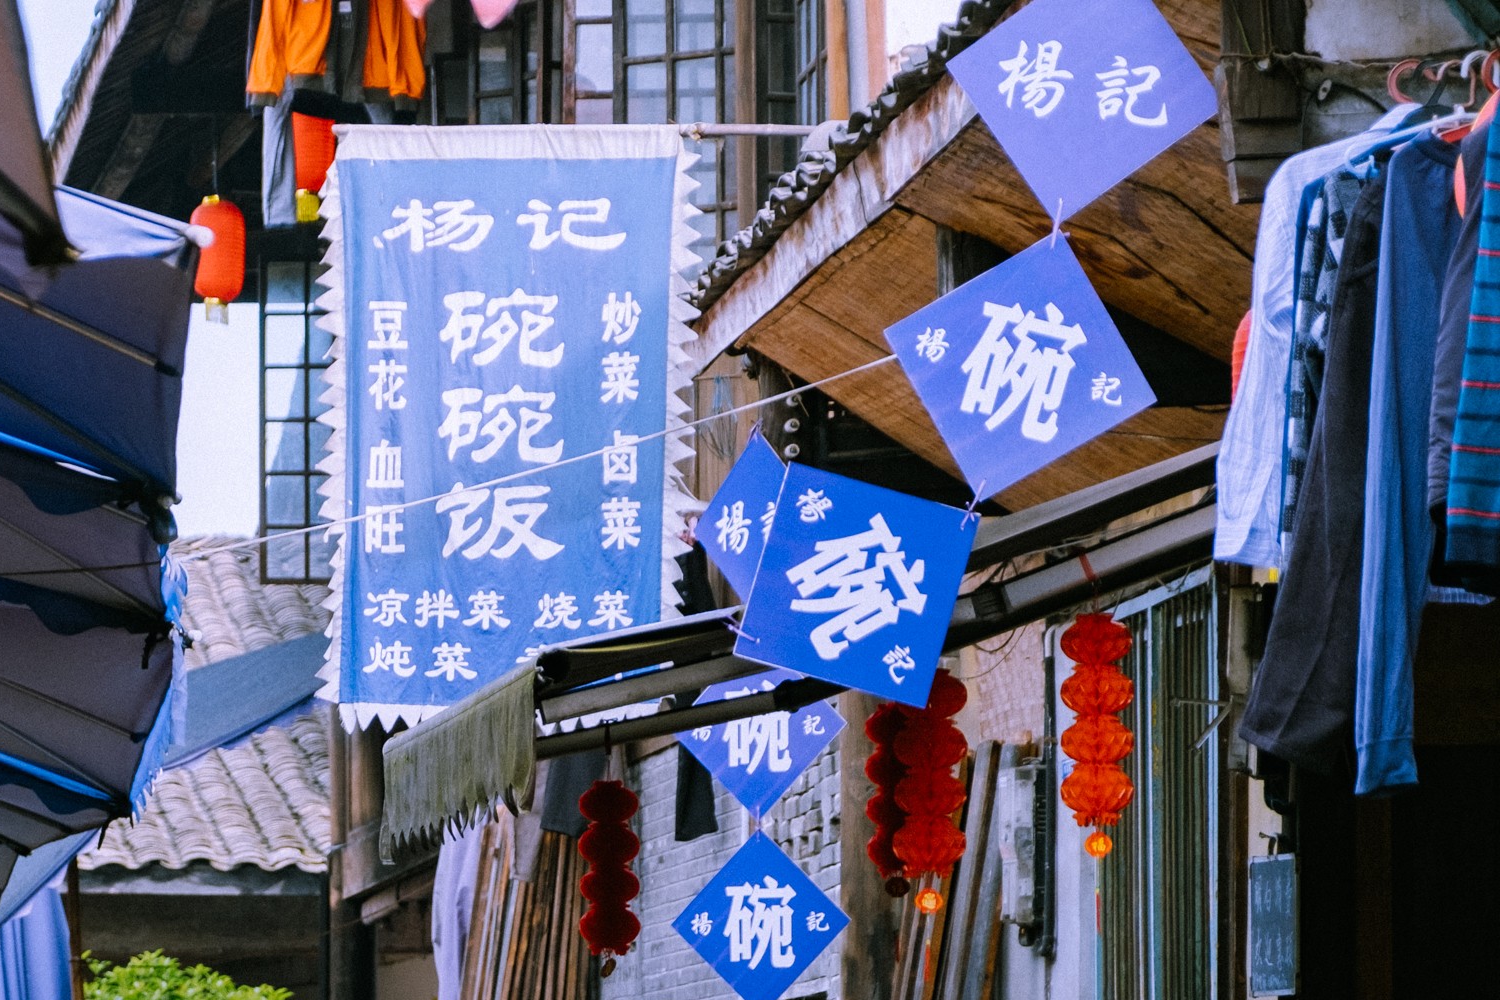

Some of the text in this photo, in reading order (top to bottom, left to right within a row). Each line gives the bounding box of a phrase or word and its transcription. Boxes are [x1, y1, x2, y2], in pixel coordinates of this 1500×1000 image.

[998, 40, 1167, 126] 楊記
[373, 198, 626, 252] 杨记
[365, 301, 408, 554] 豆花 血旺
[436, 288, 565, 560] 碗碗饭
[601, 292, 642, 550] 炒菜 卤菜
[916, 302, 1122, 443] 楊 碗 記
[364, 589, 633, 629] 凉拌菜 烧菜
[786, 512, 927, 660] 碗
[362, 642, 478, 681] 炖菜
[724, 876, 796, 969] 碗
